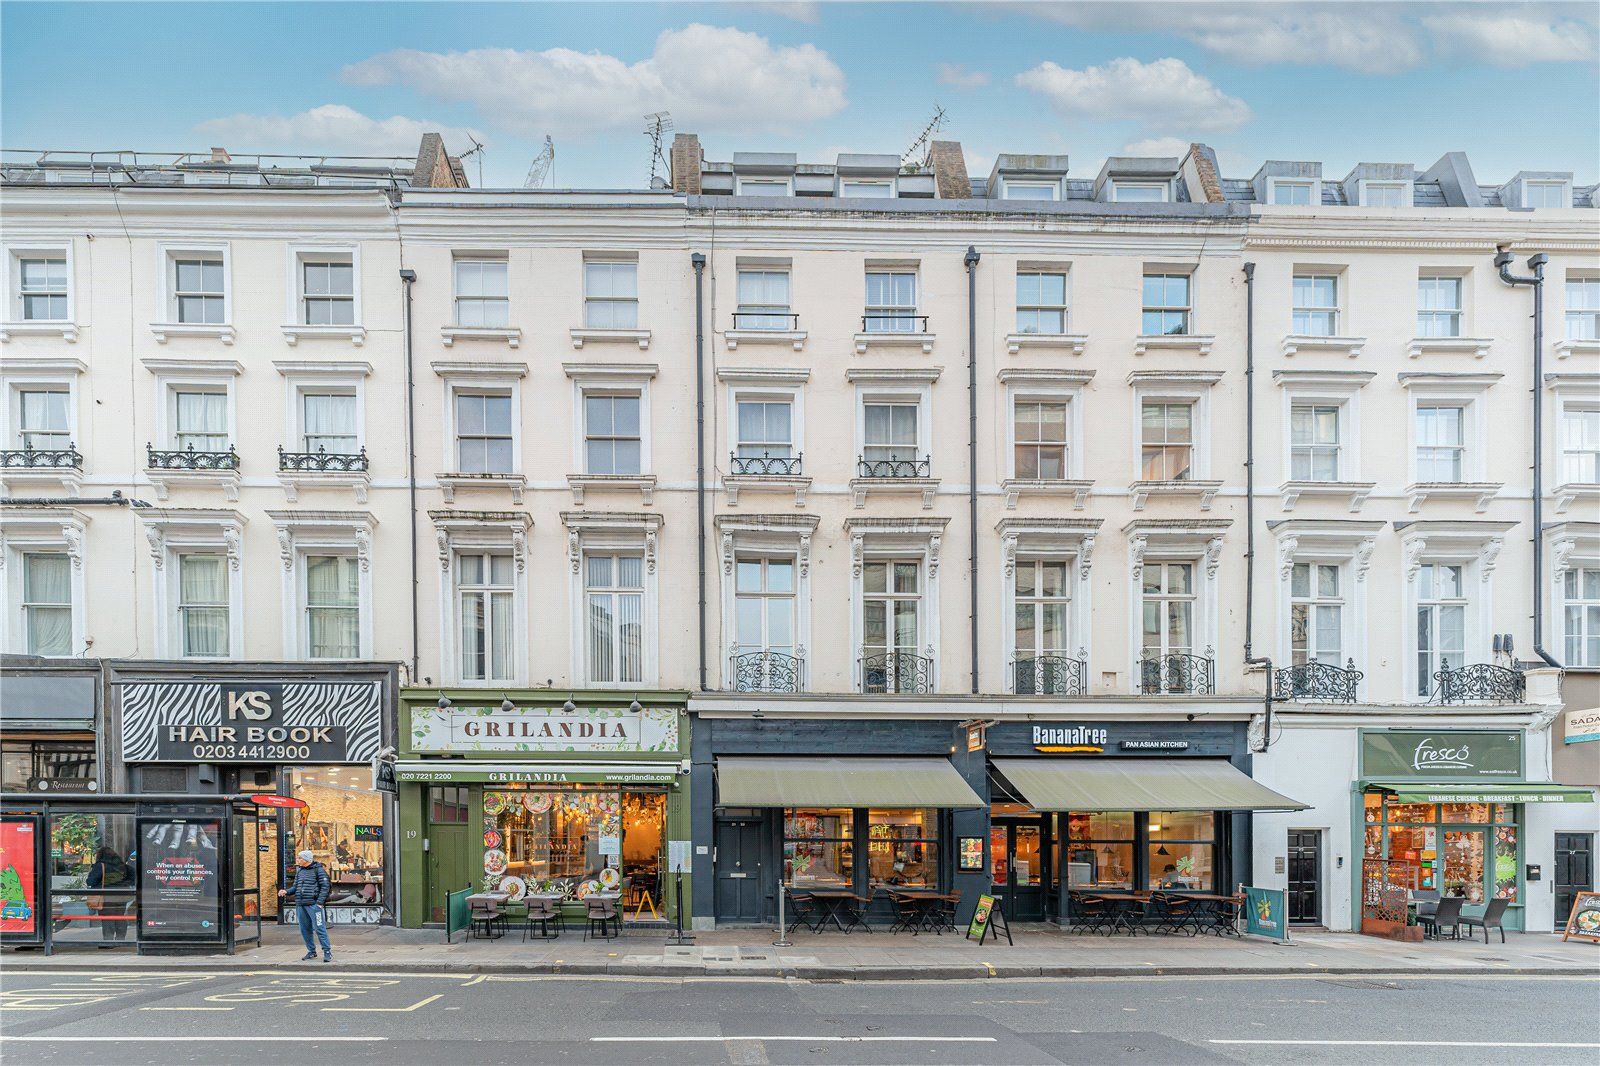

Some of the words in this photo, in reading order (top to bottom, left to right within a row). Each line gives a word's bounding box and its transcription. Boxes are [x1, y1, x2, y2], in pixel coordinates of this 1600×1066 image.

[228, 691, 272, 720] KS
[168, 727, 237, 742] HAIR
[247, 727, 333, 743] BOOK
[464, 721, 627, 738] GRILANDIA
[1033, 726, 1107, 744] BananaTree
[193, 745, 236, 759] 0203
[238, 745, 310, 759] 4412900
[401, 772, 415, 780] 020
[415, 772, 432, 780] 7221
[434, 772, 452, 780] 2200
[489, 773, 567, 781] GRILANDIA
[606, 774, 672, 782] www.grilandia.com
[356, 827, 382, 836] NAILS
[407, 830, 417, 838] 19
